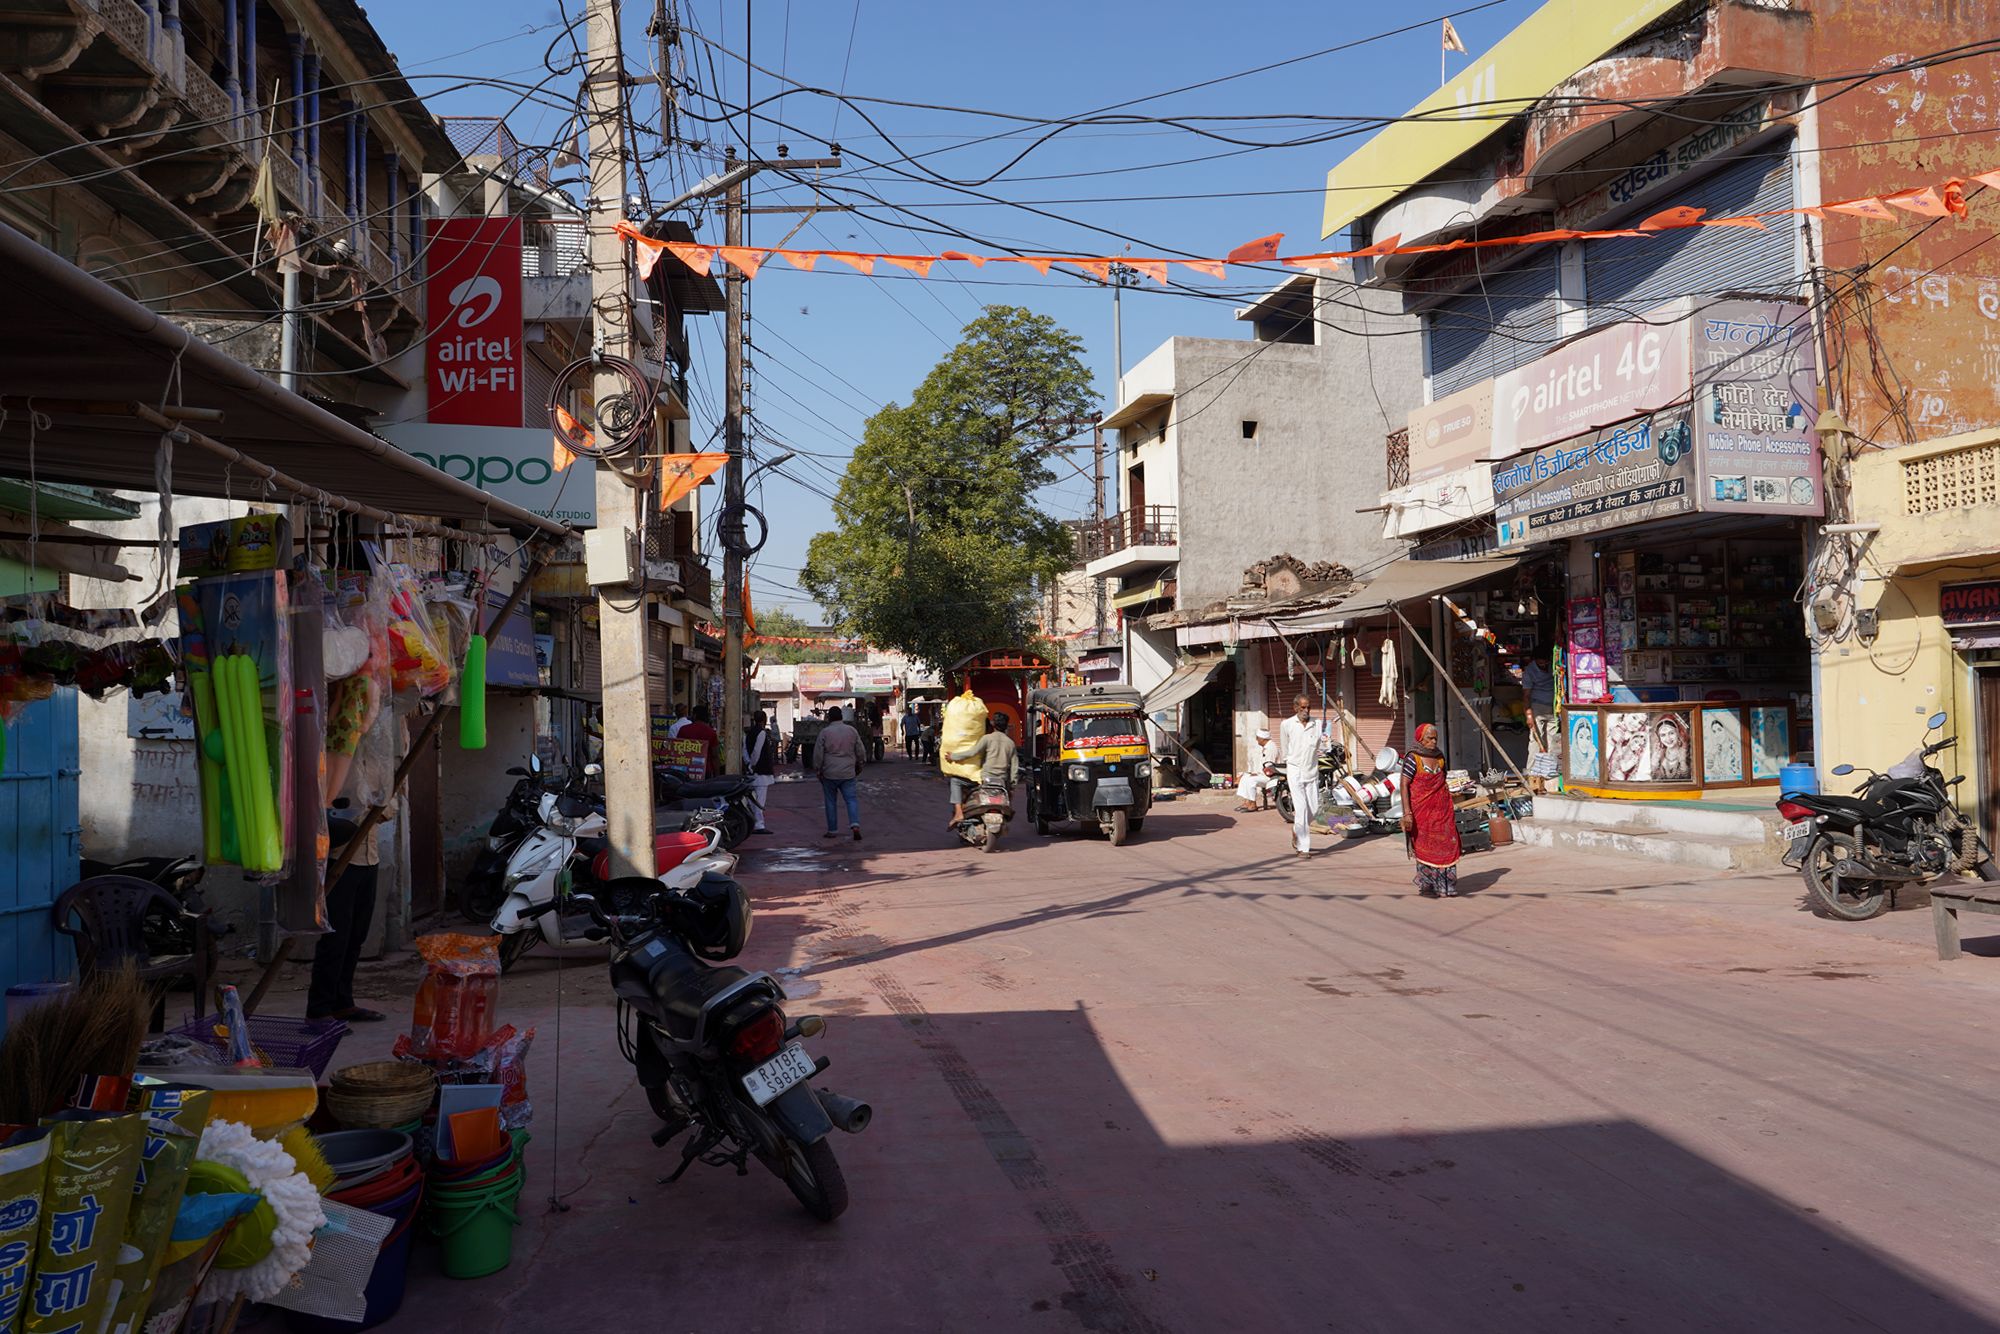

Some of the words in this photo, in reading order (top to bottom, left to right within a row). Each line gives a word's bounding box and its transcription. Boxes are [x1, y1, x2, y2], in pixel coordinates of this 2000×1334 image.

[438, 335, 513, 361] airtel
[438, 367, 515, 392] Wi-Fi
[1533, 353, 1602, 413] airtel
[1615, 332, 1661, 381] 4G
[1718, 383, 1754, 406] फोटो
[1762, 385, 1789, 407] स्टेट
[1569, 396, 1619, 421] SMARTPHONE
[1721, 407, 1788, 433] लेमीनेशन
[1708, 434, 1734, 451] Mobile
[1737, 435, 1762, 453] Phone
[1765, 438, 1811, 455] Accessories
[1493, 464, 1532, 494] सन्तोष
[1535, 446, 1589, 480] डिजीटल
[1514, 497, 1531, 513] Phone
[1536, 484, 1571, 507] Accessories
[556, 510, 591, 520] STUDIO
